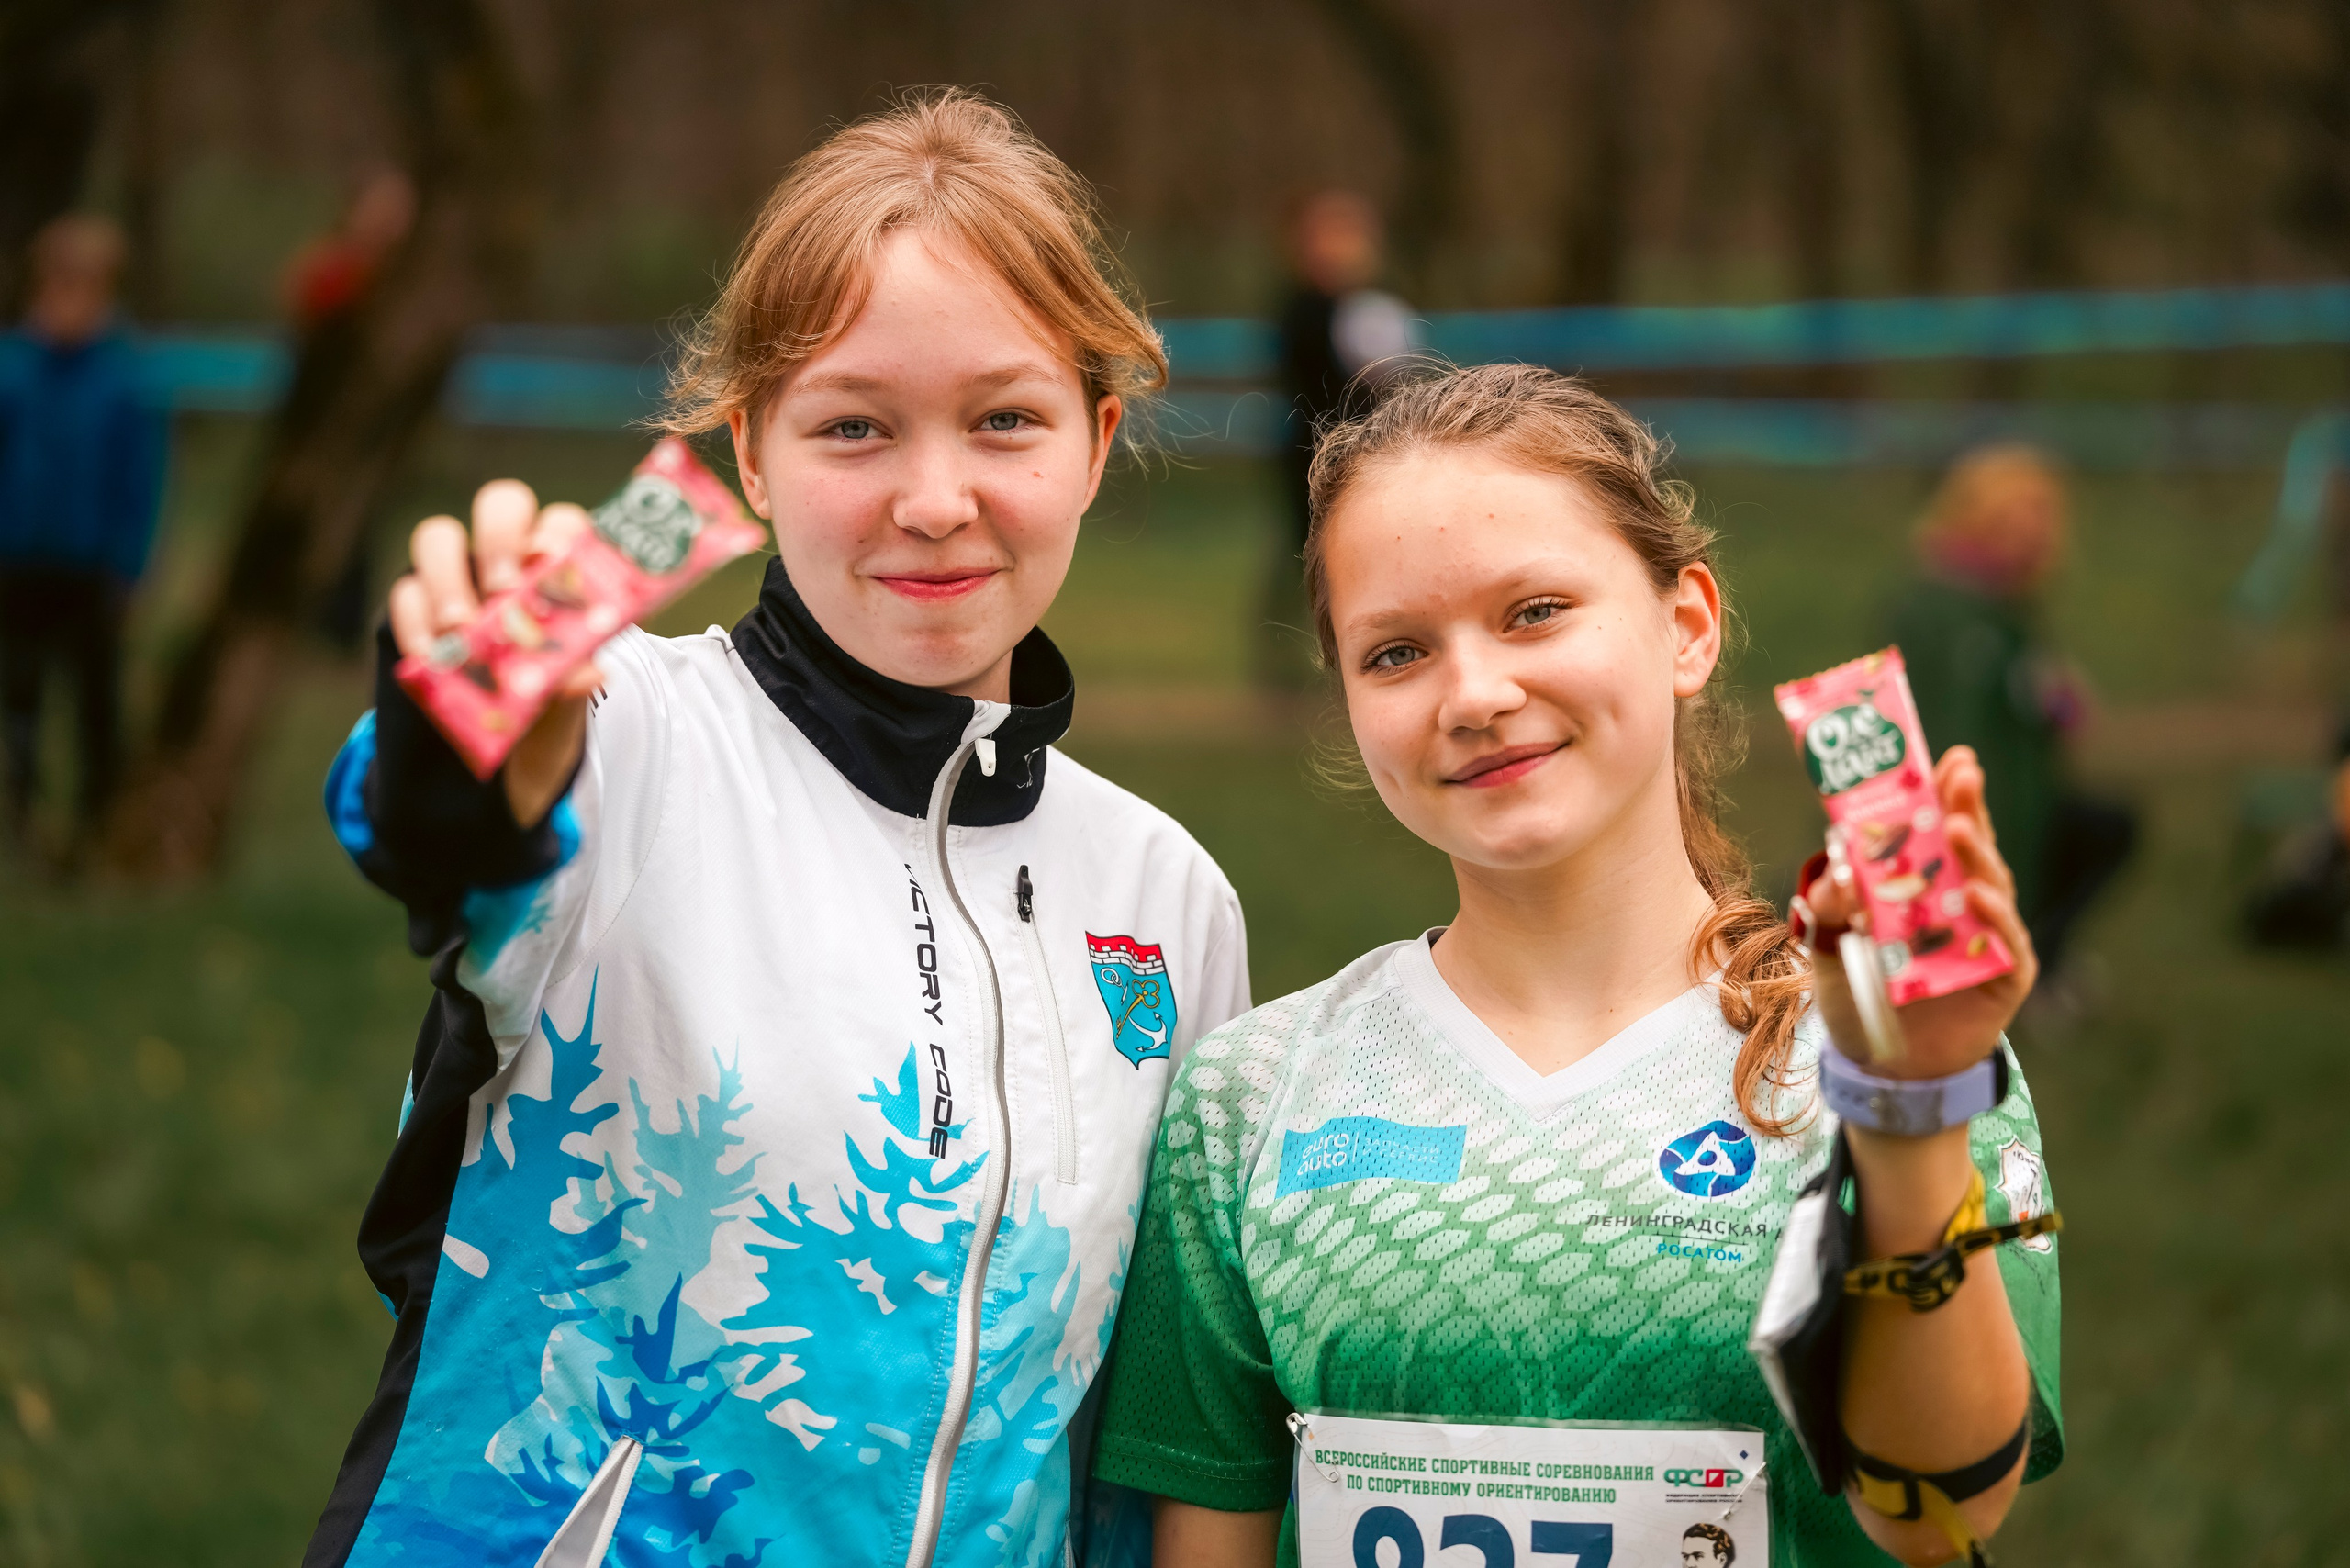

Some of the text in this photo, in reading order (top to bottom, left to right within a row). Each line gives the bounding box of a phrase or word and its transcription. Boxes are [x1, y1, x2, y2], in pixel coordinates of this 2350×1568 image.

[928, 1042, 954, 1160] CODE
[1302, 1133, 1349, 1159] euro
[1364, 1137, 1439, 1155] ЗАПЧАСТИ
[1379, 1148, 1439, 1163] СЕРВИС
[1296, 1150, 1347, 1175] auto
[1584, 1214, 1767, 1239] ЛЕНИНГРАДСКАЯ
[1657, 1242, 1742, 1263] РОСАТОМ
[1315, 1449, 1654, 1481] ВСЕРОССИЙСКИЕ СПОРТИВНЫЕ СОРЕВНОВАНИЯ
[1347, 1473, 1617, 1503] ПО СПОРТИВНОМУ ОРИЕНТИРОВАНИЮ
